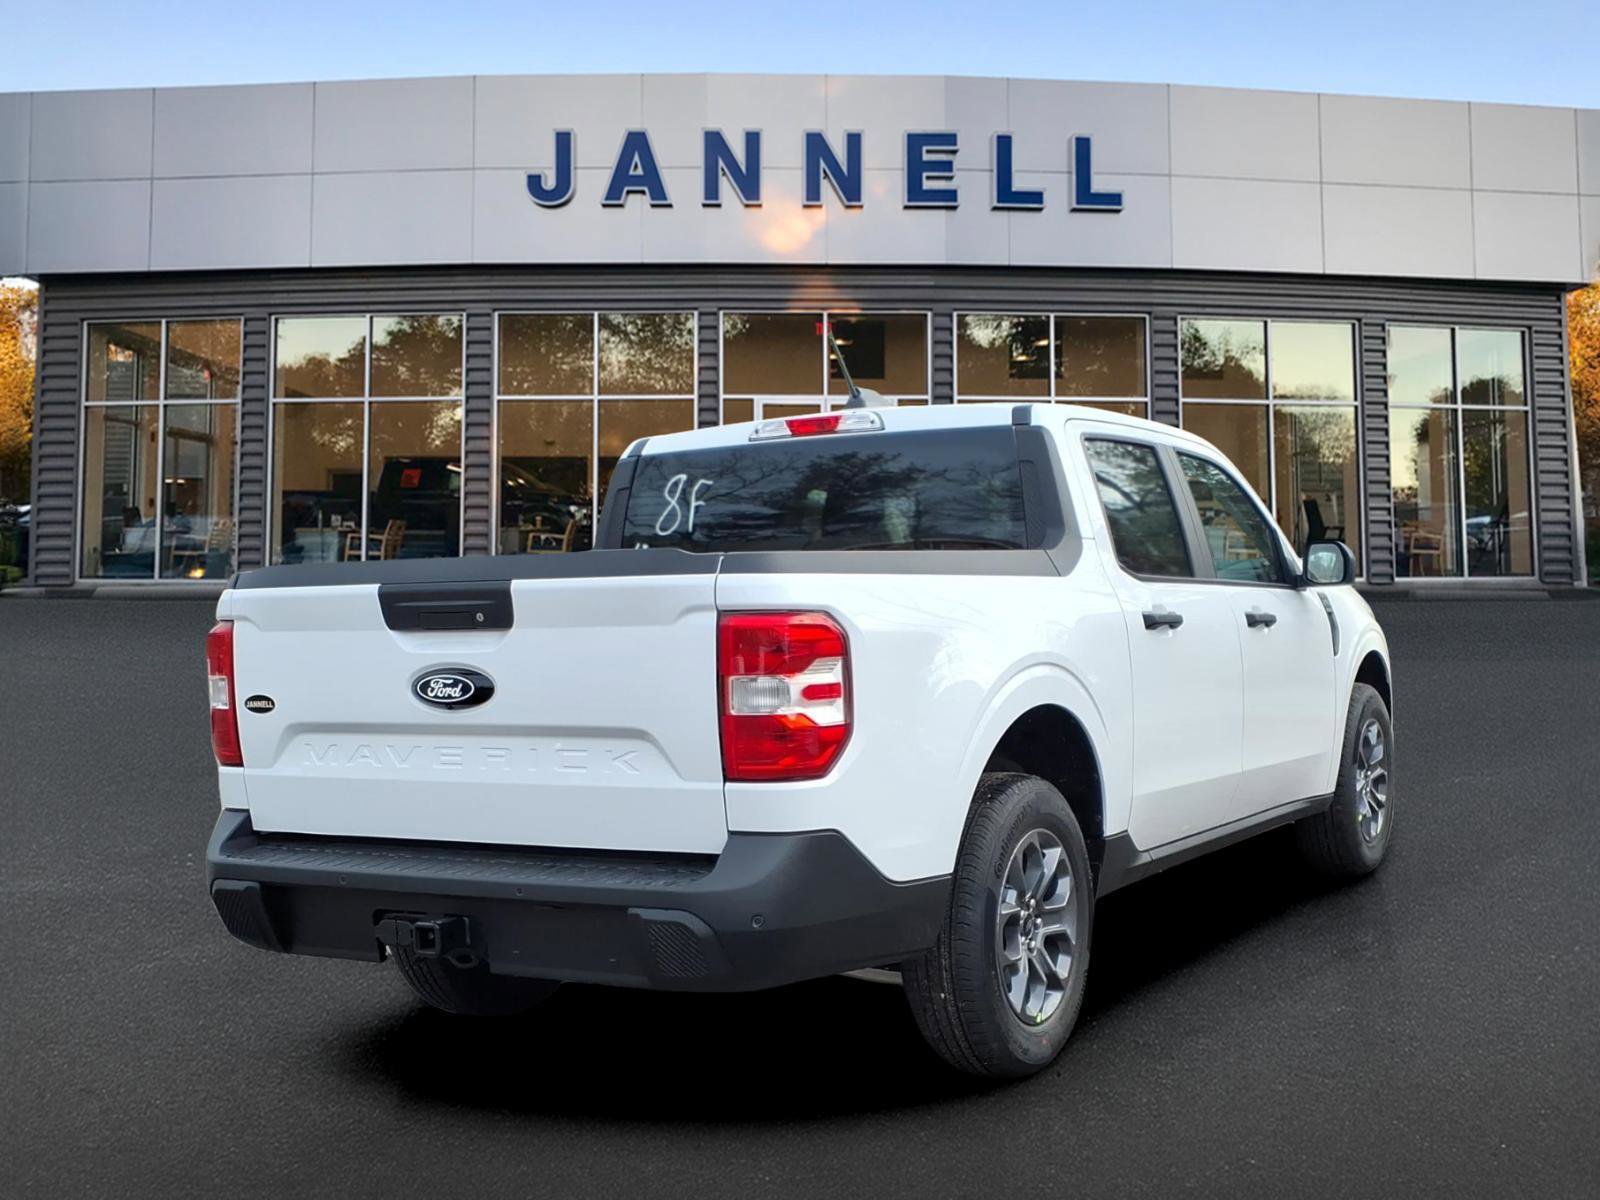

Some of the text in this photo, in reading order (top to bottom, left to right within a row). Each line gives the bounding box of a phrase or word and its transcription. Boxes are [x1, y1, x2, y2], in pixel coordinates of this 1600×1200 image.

[526, 128, 1124, 212] JANNELL
[656, 474, 713, 535] 8F
[246, 700, 274, 708] JANNELL
[427, 678, 463, 697] Ford
[303, 742, 641, 776] MAVERICK
